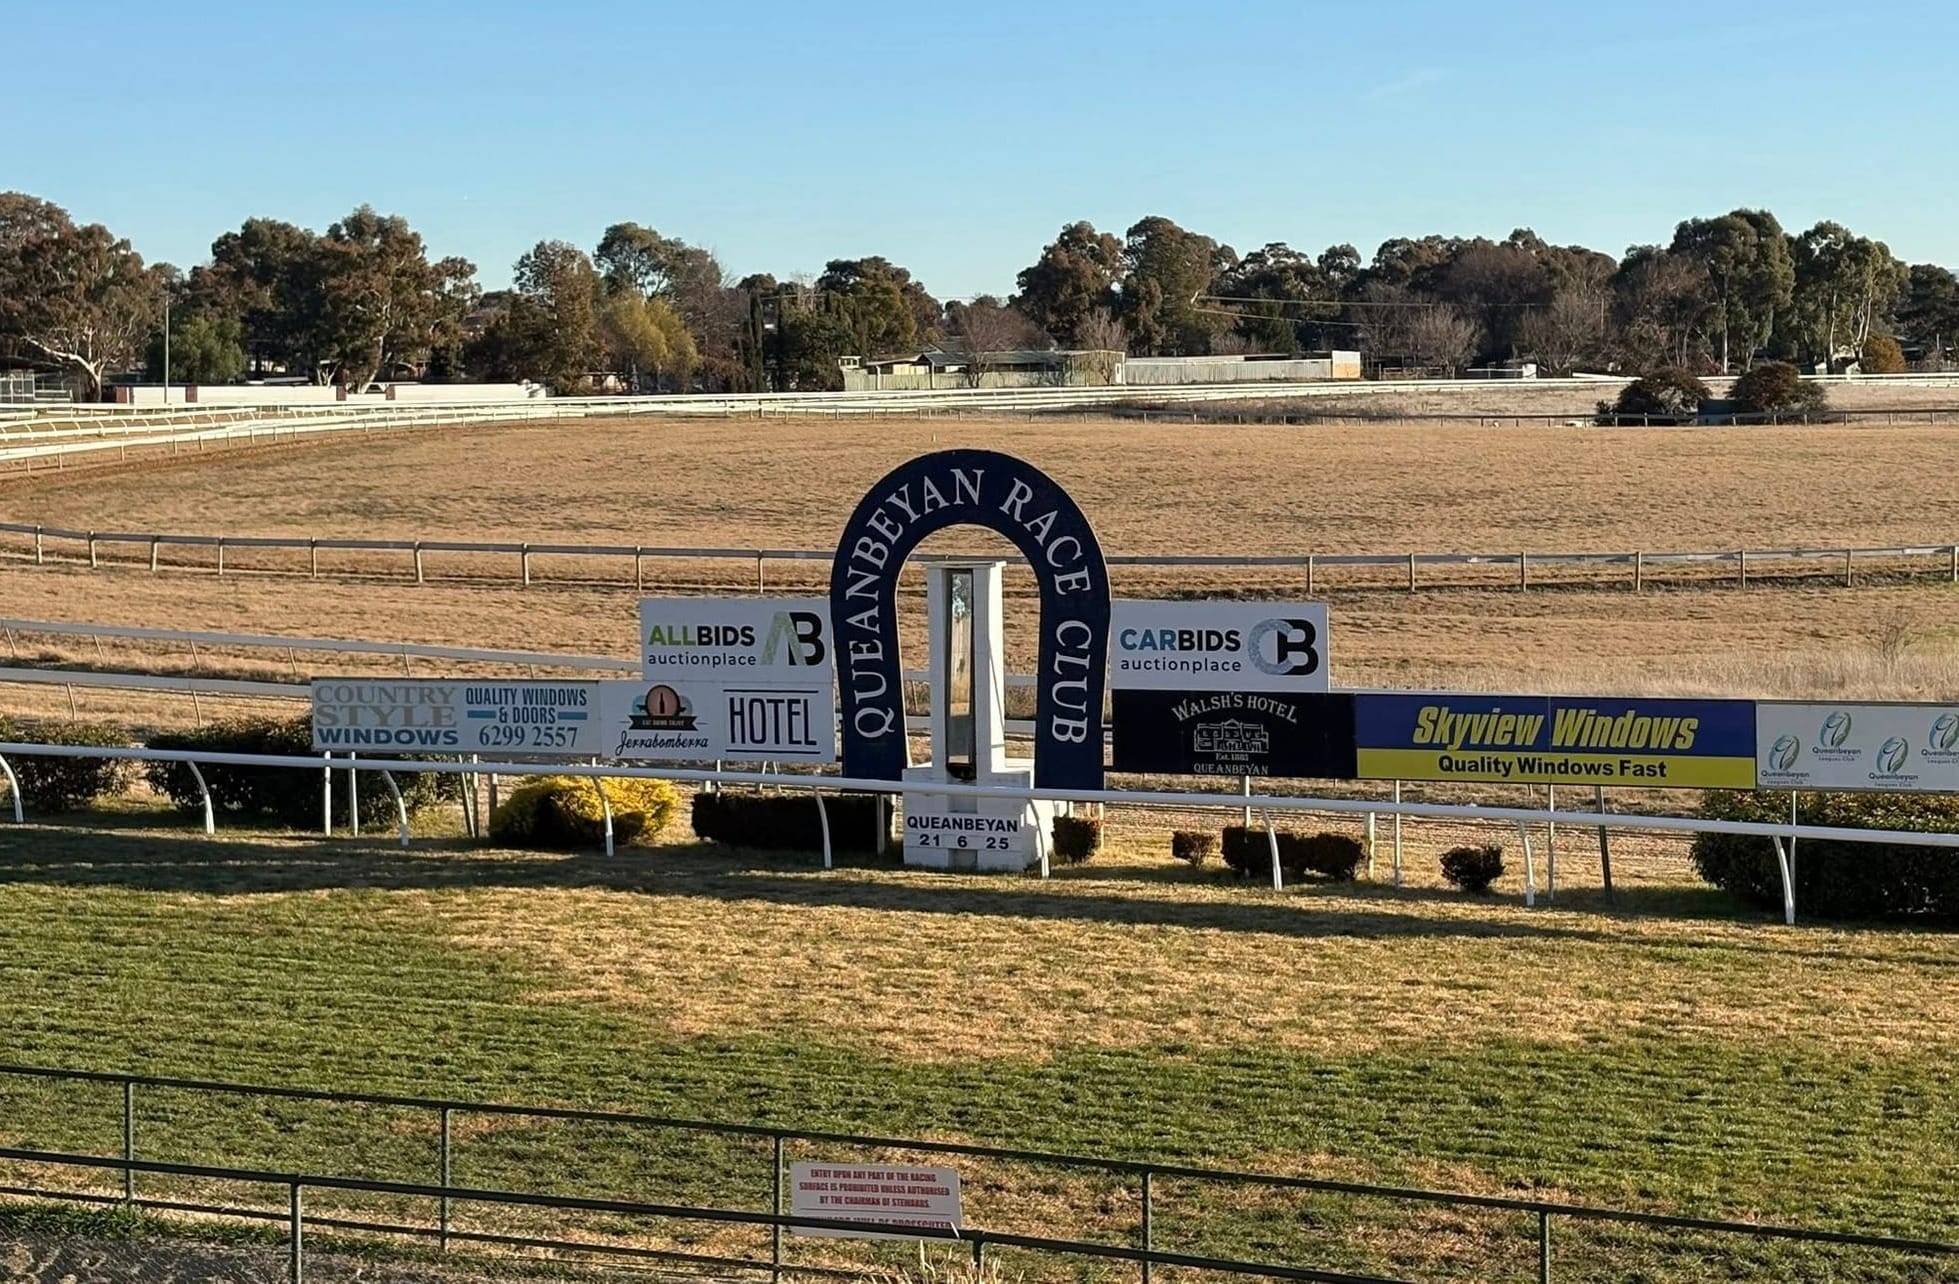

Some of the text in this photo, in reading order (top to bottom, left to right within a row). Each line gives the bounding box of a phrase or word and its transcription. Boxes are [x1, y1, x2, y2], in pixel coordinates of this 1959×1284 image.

[846, 468, 1092, 744] QUEANBEYAN RACE CLUB
[648, 624, 756, 646] ALLBIDS
[1120, 628, 1241, 652] CARBIDS
[648, 652, 756, 668] auctionplace
[1120, 656, 1241, 674] auctionplace
[315, 685, 457, 704] COUNTRY
[466, 687, 588, 706] QUALITY WINDOWS
[316, 704, 456, 728] STYLE
[499, 707, 556, 724] & DOORS
[1171, 692, 1298, 724] WALSH'S HOTEL
[730, 697, 816, 746] HOTEL
[1412, 706, 1698, 751] Skyview Windows
[318, 728, 459, 746] WINDOWS
[479, 726, 578, 748] 6299 2557
[615, 730, 709, 756] Jerrabomberra
[1194, 762, 1268, 775] QUEANBEYAN
[1438, 755, 1666, 778] Quality Windows Fast
[907, 816, 1018, 832] QUEANBEYAN
[920, 834, 1008, 850] 21 6 25
[811, 1169, 832, 1178] ENTRY
[833, 1170, 851, 1178] UPON
[853, 1171, 866, 1179] ANY
[868, 1172, 885, 1180] PART
[911, 1173, 936, 1182] RACING
[800, 1182, 950, 1196] SURFACE IS PROHIBITED UNLESS AUTHORISED
[820, 1196, 828, 1204] BY
[845, 1197, 880, 1206] CHAIRMAN
